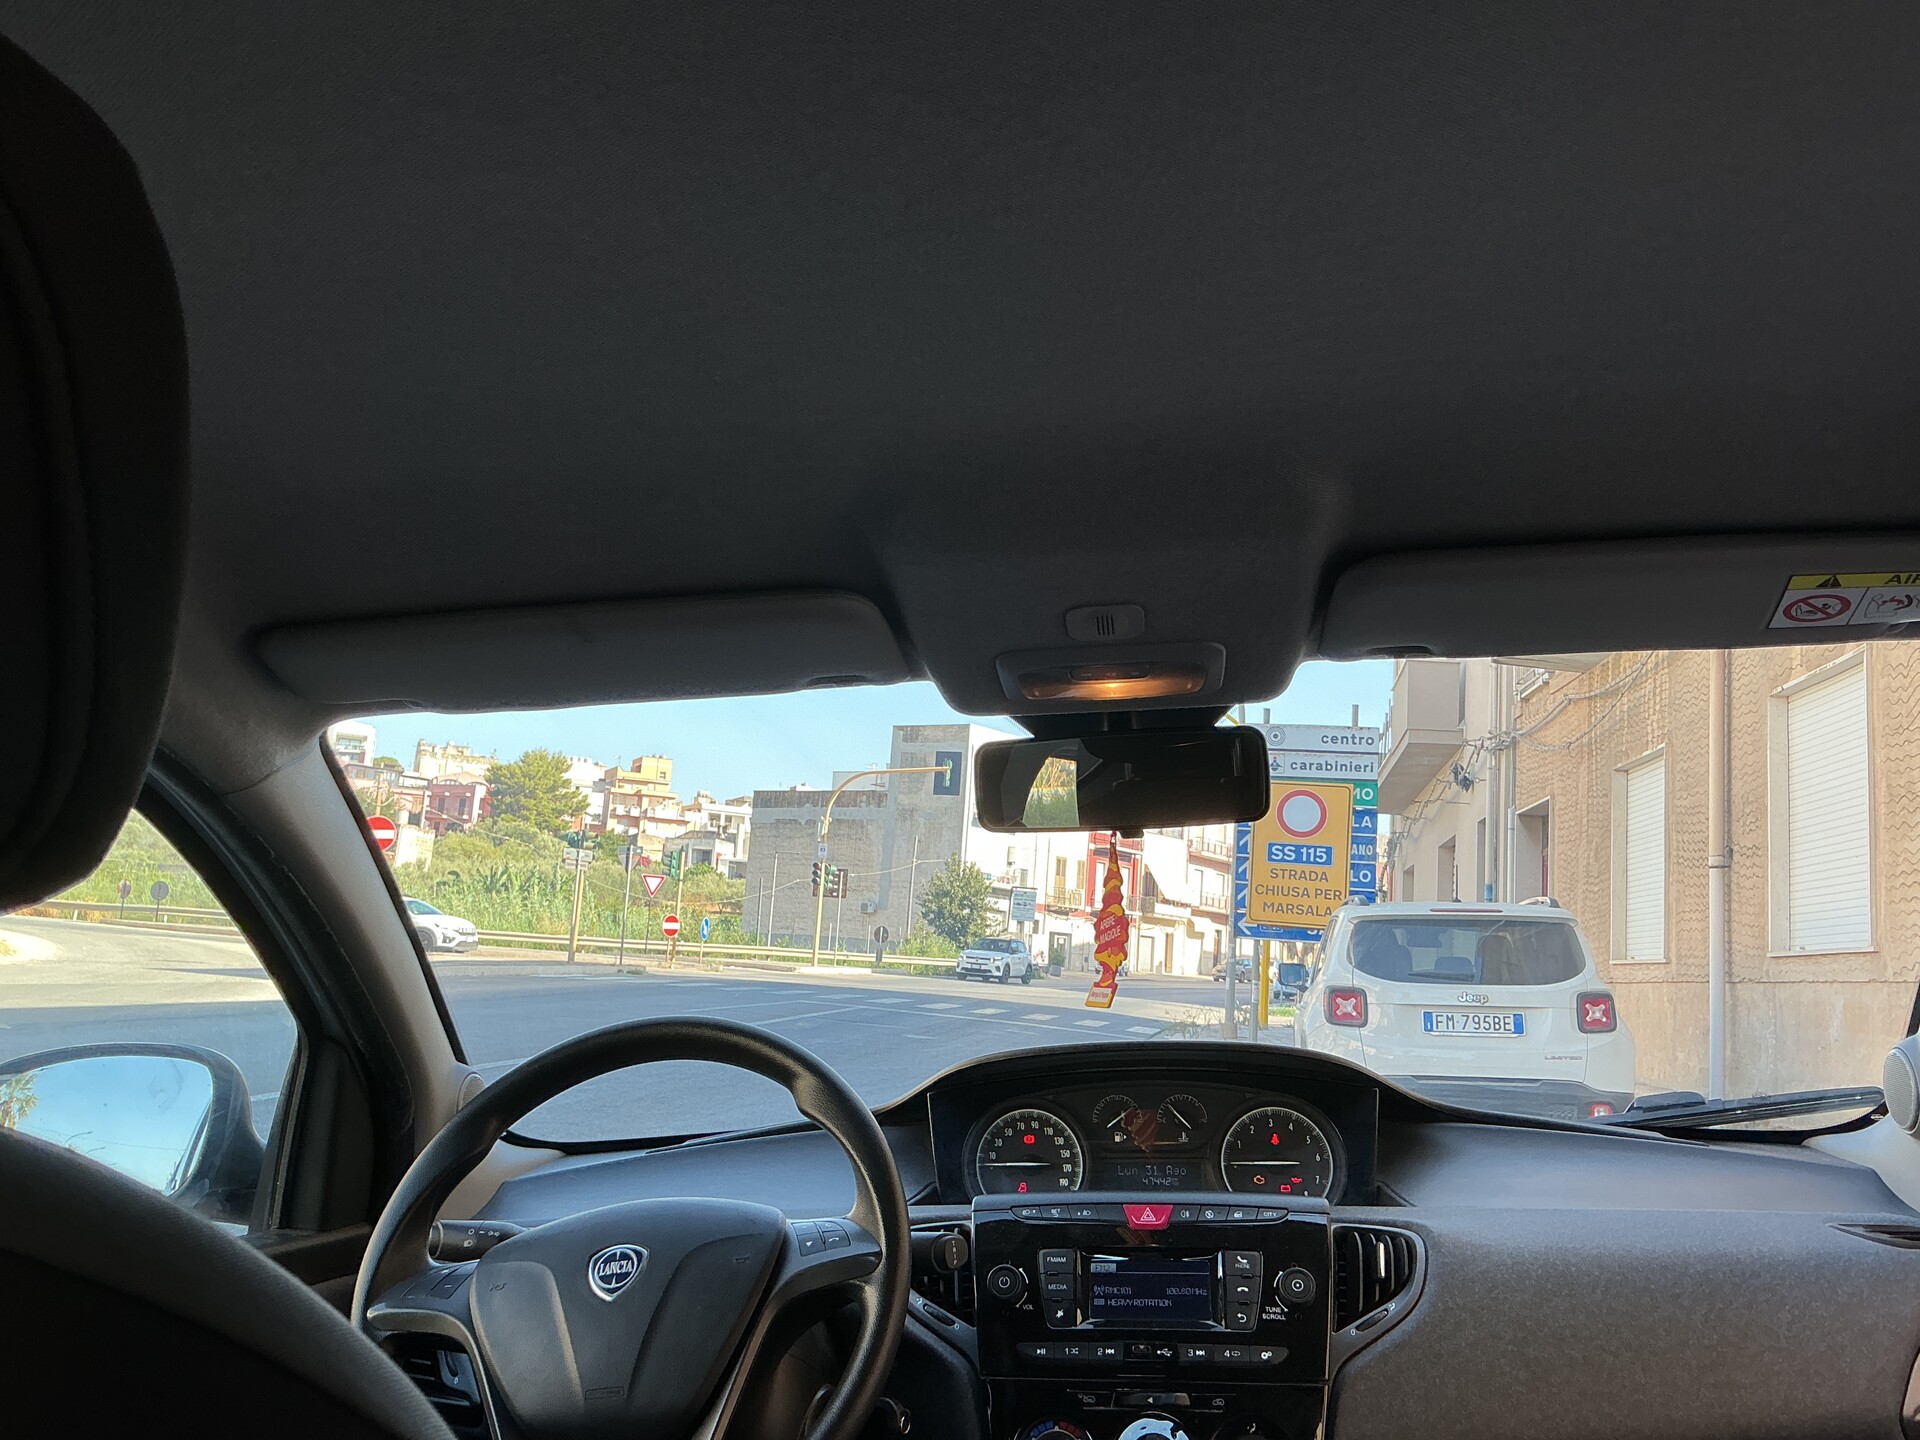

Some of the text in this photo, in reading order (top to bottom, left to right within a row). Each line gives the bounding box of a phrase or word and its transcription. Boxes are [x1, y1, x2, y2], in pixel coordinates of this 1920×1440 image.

[1321, 733, 1375, 746] centro
[1290, 760, 1374, 773] carabinieri
[1271, 845, 1327, 863] SS 115
[1270, 867, 1329, 883] STRADA
[1254, 883, 1342, 901] CHIUSA PER
[1262, 902, 1333, 918] MARSALA
[1457, 991, 1489, 1005] Jeep
[1016, 1122, 1025, 1130] 70
[1031, 1121, 1039, 1129] 90
[1268, 1119, 1273, 1127] 3
[1288, 1122, 1294, 1131] 4
[1004, 1128, 1013, 1136] 50
[1043, 1127, 1054, 1136] 110
[1249, 1125, 1255, 1134] 2
[994, 1138, 1003, 1147] 30
[1053, 1136, 1065, 1145] 130
[1306, 1135, 1311, 1144] 5
[989, 1151, 997, 1160] 10
[1060, 1149, 1070, 1158] 150
[1315, 1153, 1321, 1162] 6
[1062, 1164, 1072, 1173] 170
[1117, 1165, 1187, 1176] Lun 31 Ago
[1059, 1178, 1069, 1187] 190
[1315, 1175, 1320, 1184] 7
[598, 1259, 633, 1277] LANCIA
[1097, 1347, 1103, 1356] 2
[1187, 1348, 1194, 1357] 3
[1223, 1349, 1230, 1358] 4
